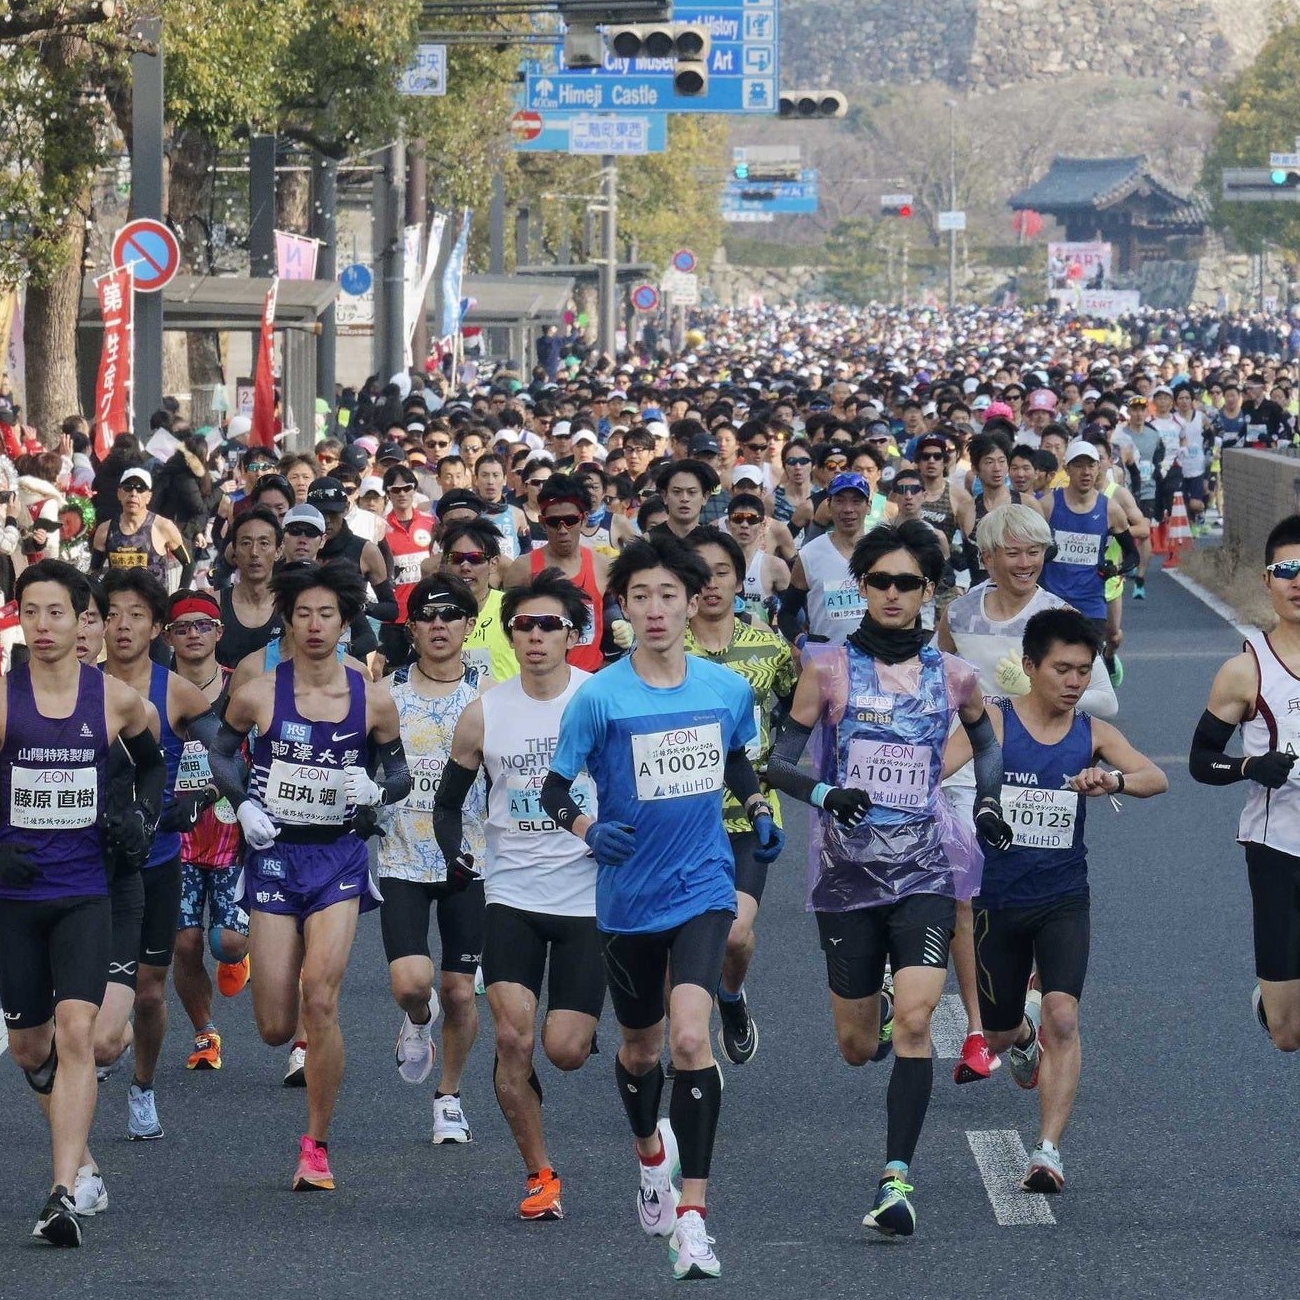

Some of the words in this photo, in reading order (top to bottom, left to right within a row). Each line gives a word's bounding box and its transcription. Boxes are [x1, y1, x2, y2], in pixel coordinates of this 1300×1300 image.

[604, 50, 630, 74] City
[713, 50, 733, 71] Art
[558, 84, 603, 109] Himeji
[611, 84, 658, 105] Castle
[99, 282, 123, 451] 第一生命グル
[827, 593, 867, 607] A111
[287, 723, 307, 736] HRS
[525, 736, 557, 753] THE
[18, 748, 95, 763] 山陽特殊製鋼
[639, 749, 720, 777] A10029
[180, 760, 200, 772] 植田
[850, 764, 926, 786] A10111
[1004, 771, 1039, 785] TWA
[14, 788, 52, 808] 藤原
[57, 788, 95, 808] 直樹
[277, 781, 315, 804] 田丸
[318, 787, 337, 806] 颯
[1009, 808, 1072, 828] 10125
[263, 858, 282, 872] HRS
[256, 890, 286, 904] 駒大
